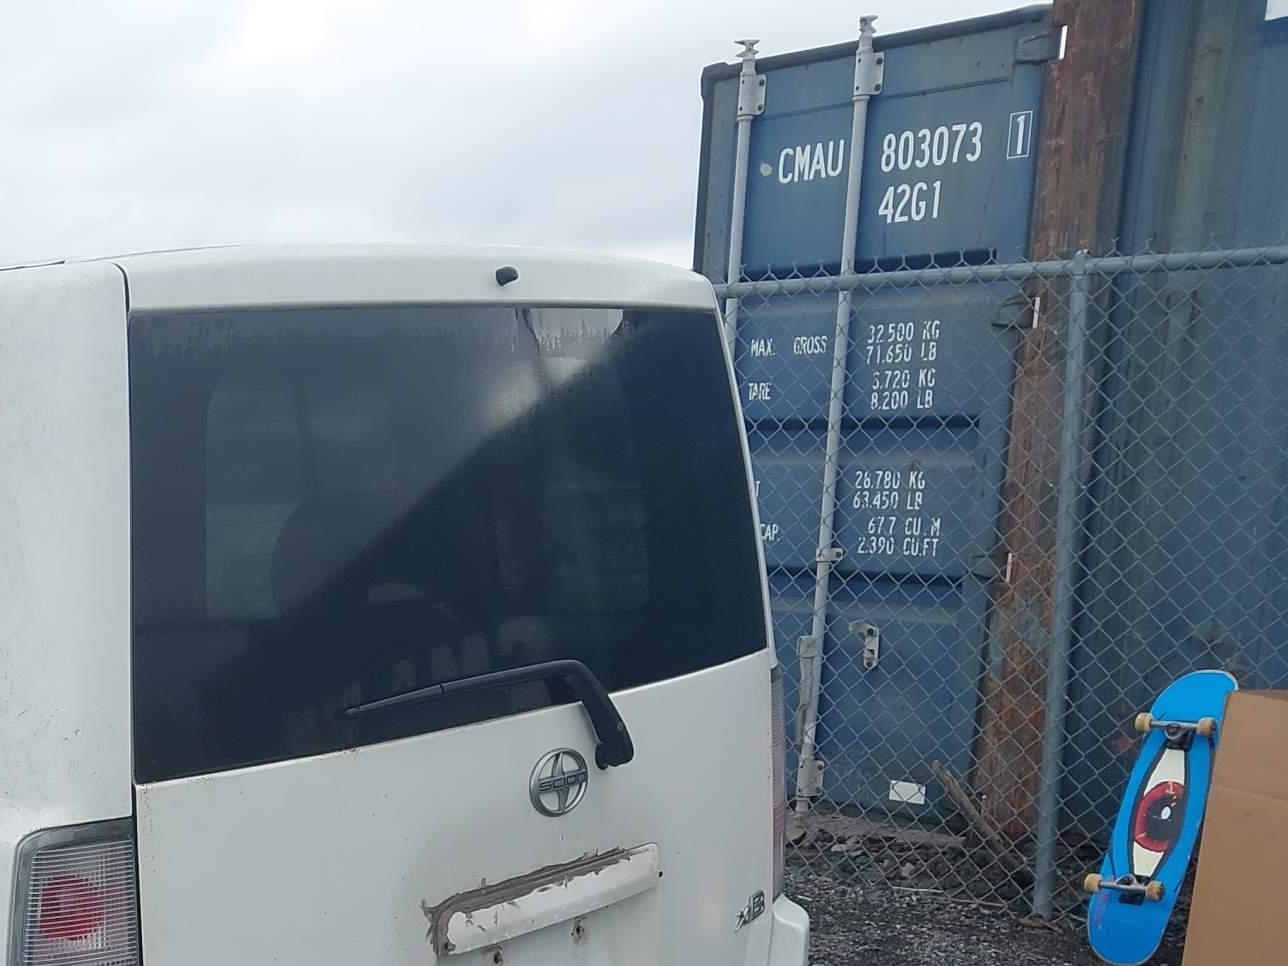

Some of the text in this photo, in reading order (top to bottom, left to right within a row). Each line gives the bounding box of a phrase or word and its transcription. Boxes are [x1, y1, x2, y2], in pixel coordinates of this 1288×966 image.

[778, 115, 1026, 184] CMAU 803073 1
[878, 181, 942, 224] 42G1
[793, 336, 828, 355] GROSS
[867, 322, 915, 344] 32500
[922, 320, 940, 340] KG
[921, 341, 937, 361] LB
[748, 382, 772, 401] TARE
[918, 368, 936, 388] KG
[871, 389, 933, 411] 8.200 LB
[909, 471, 926, 489] KG
[906, 491, 923, 511] LB
